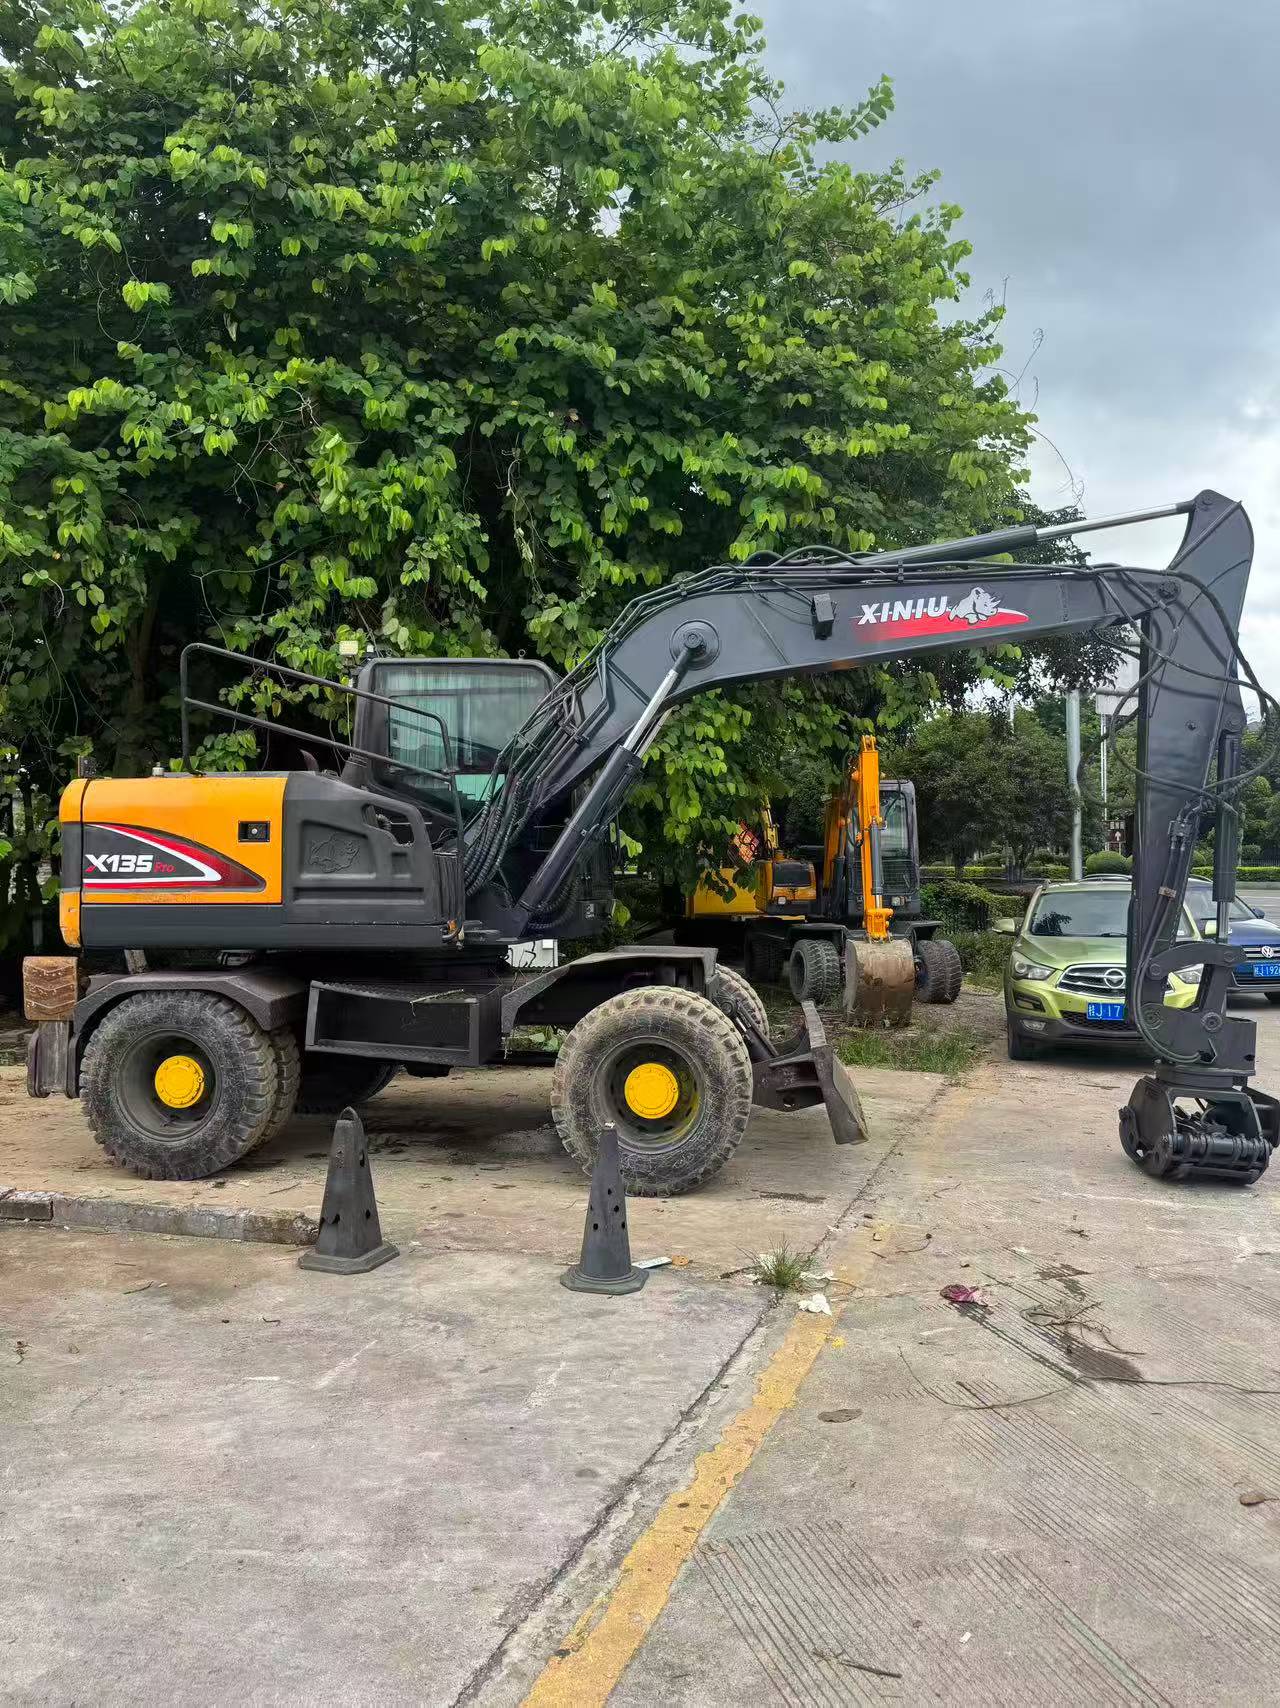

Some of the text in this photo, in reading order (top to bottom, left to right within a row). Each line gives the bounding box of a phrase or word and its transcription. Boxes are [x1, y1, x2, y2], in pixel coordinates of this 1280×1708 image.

[857, 596, 948, 625] XINIU
[84, 854, 176, 873] X135 Pro
